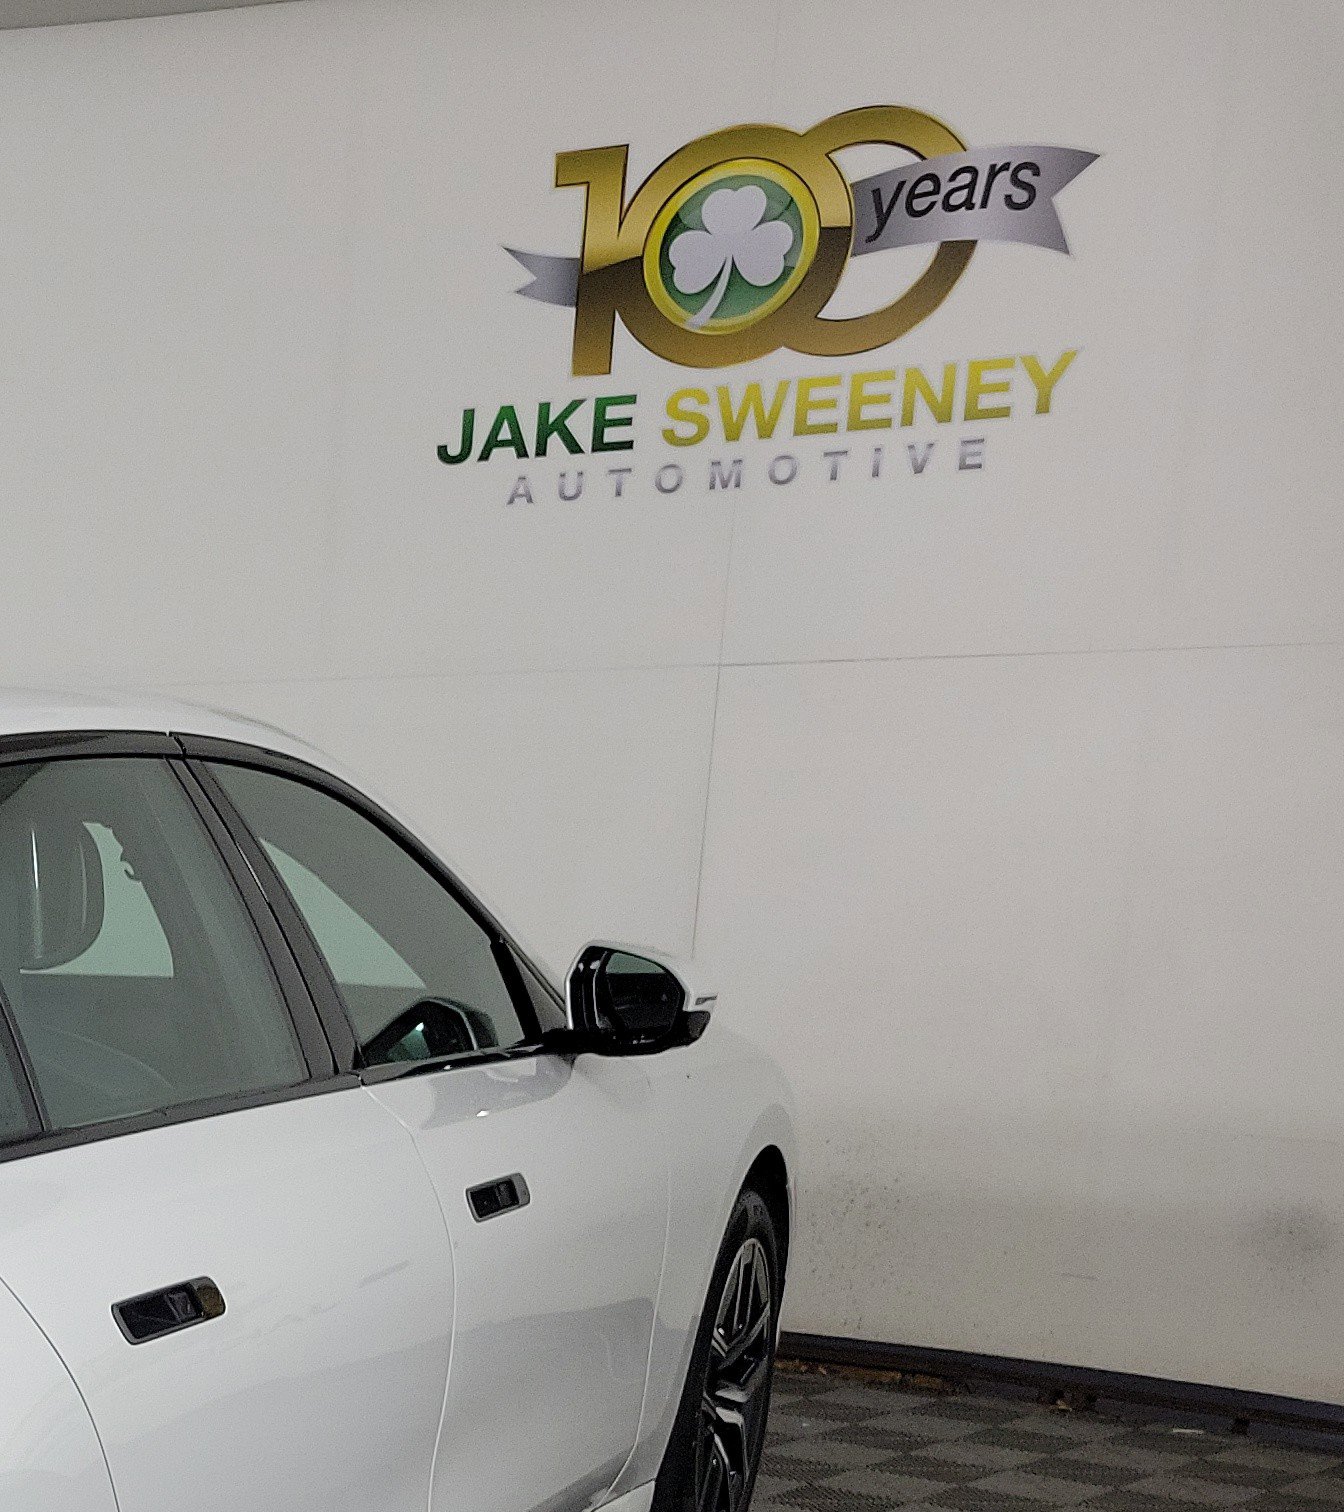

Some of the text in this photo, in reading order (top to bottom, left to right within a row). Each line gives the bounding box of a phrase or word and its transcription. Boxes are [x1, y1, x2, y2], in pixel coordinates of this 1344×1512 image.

[555, 104, 1040, 376] 100 years
[436, 349, 1080, 466] JAKE SWEENEY
[506, 438, 986, 506] AUTOMOTIVE
